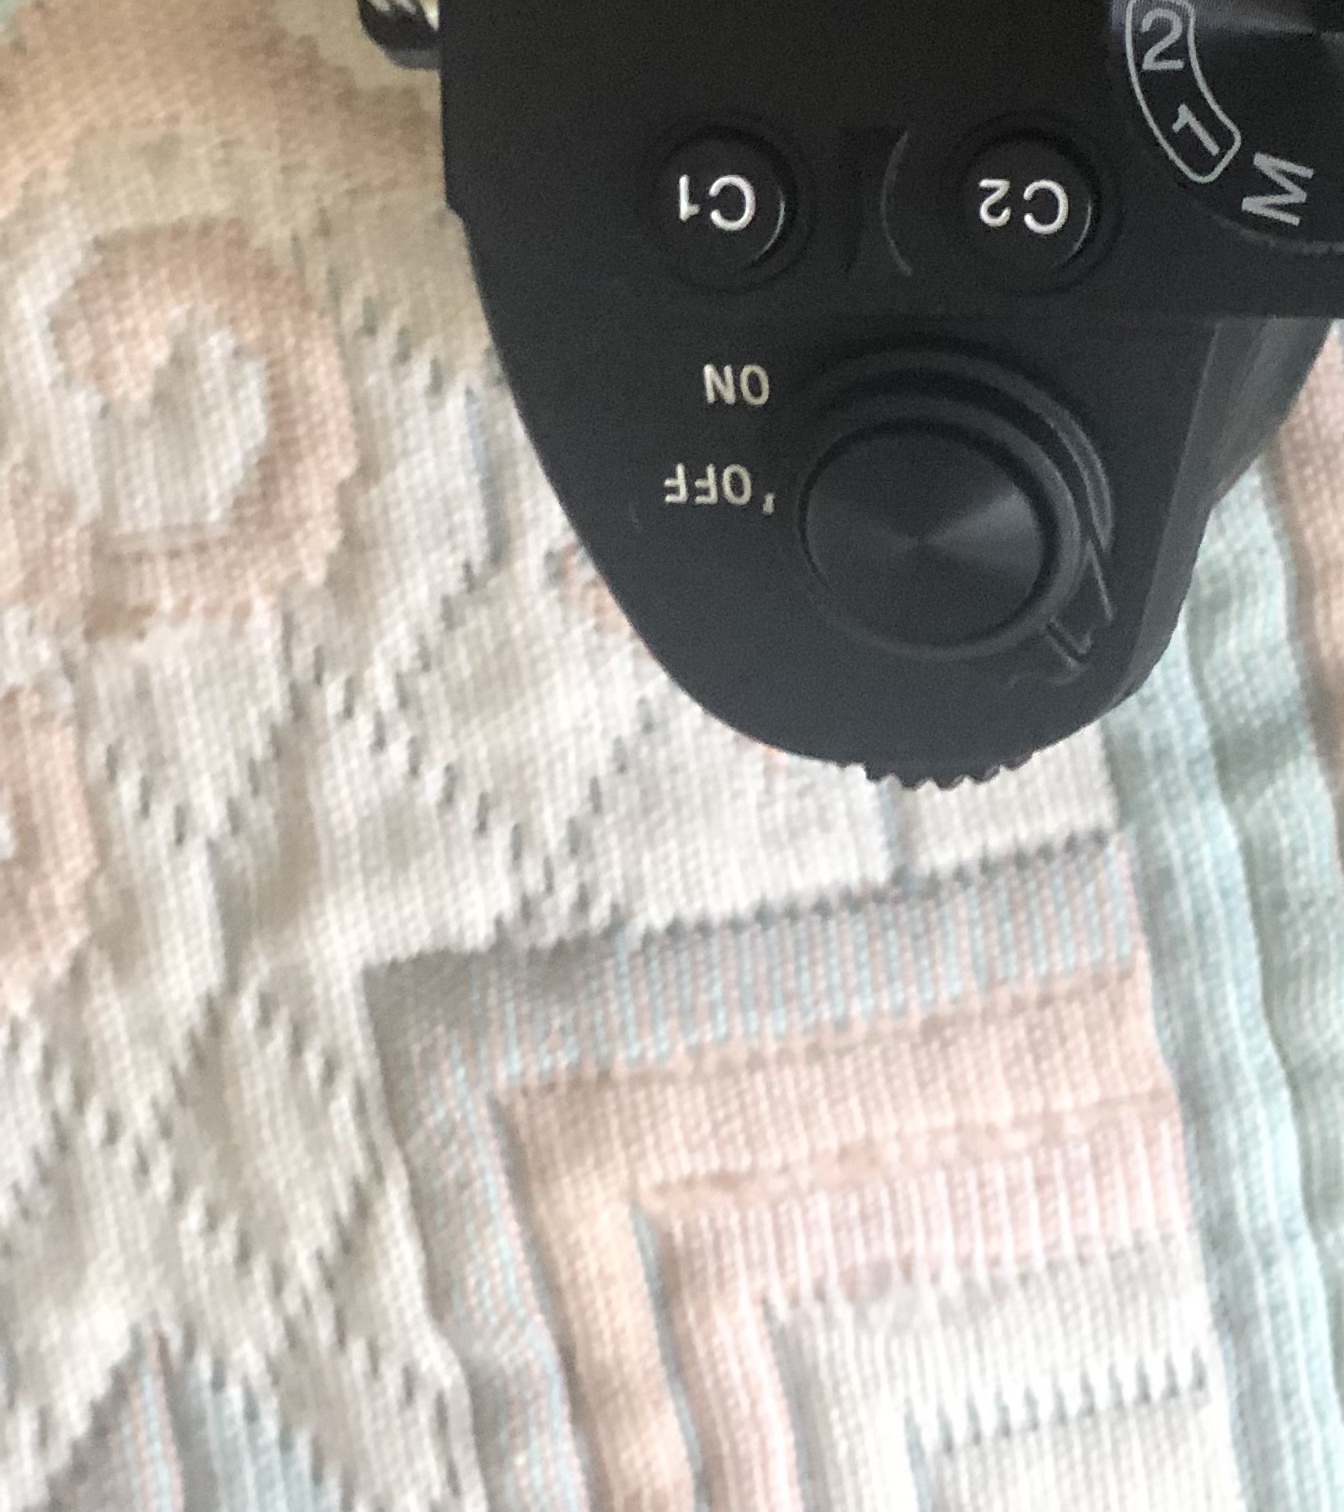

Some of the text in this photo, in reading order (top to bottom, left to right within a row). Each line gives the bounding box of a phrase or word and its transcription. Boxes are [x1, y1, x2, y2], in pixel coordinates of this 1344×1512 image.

[1141, 7, 1185, 71] 2
[1172, 103, 1220, 157] 1
[678, 174, 756, 231] C1
[978, 178, 1069, 235] C2
[1241, 151, 1314, 227] M
[702, 363, 770, 406] ON
[663, 463, 752, 505] OFF
